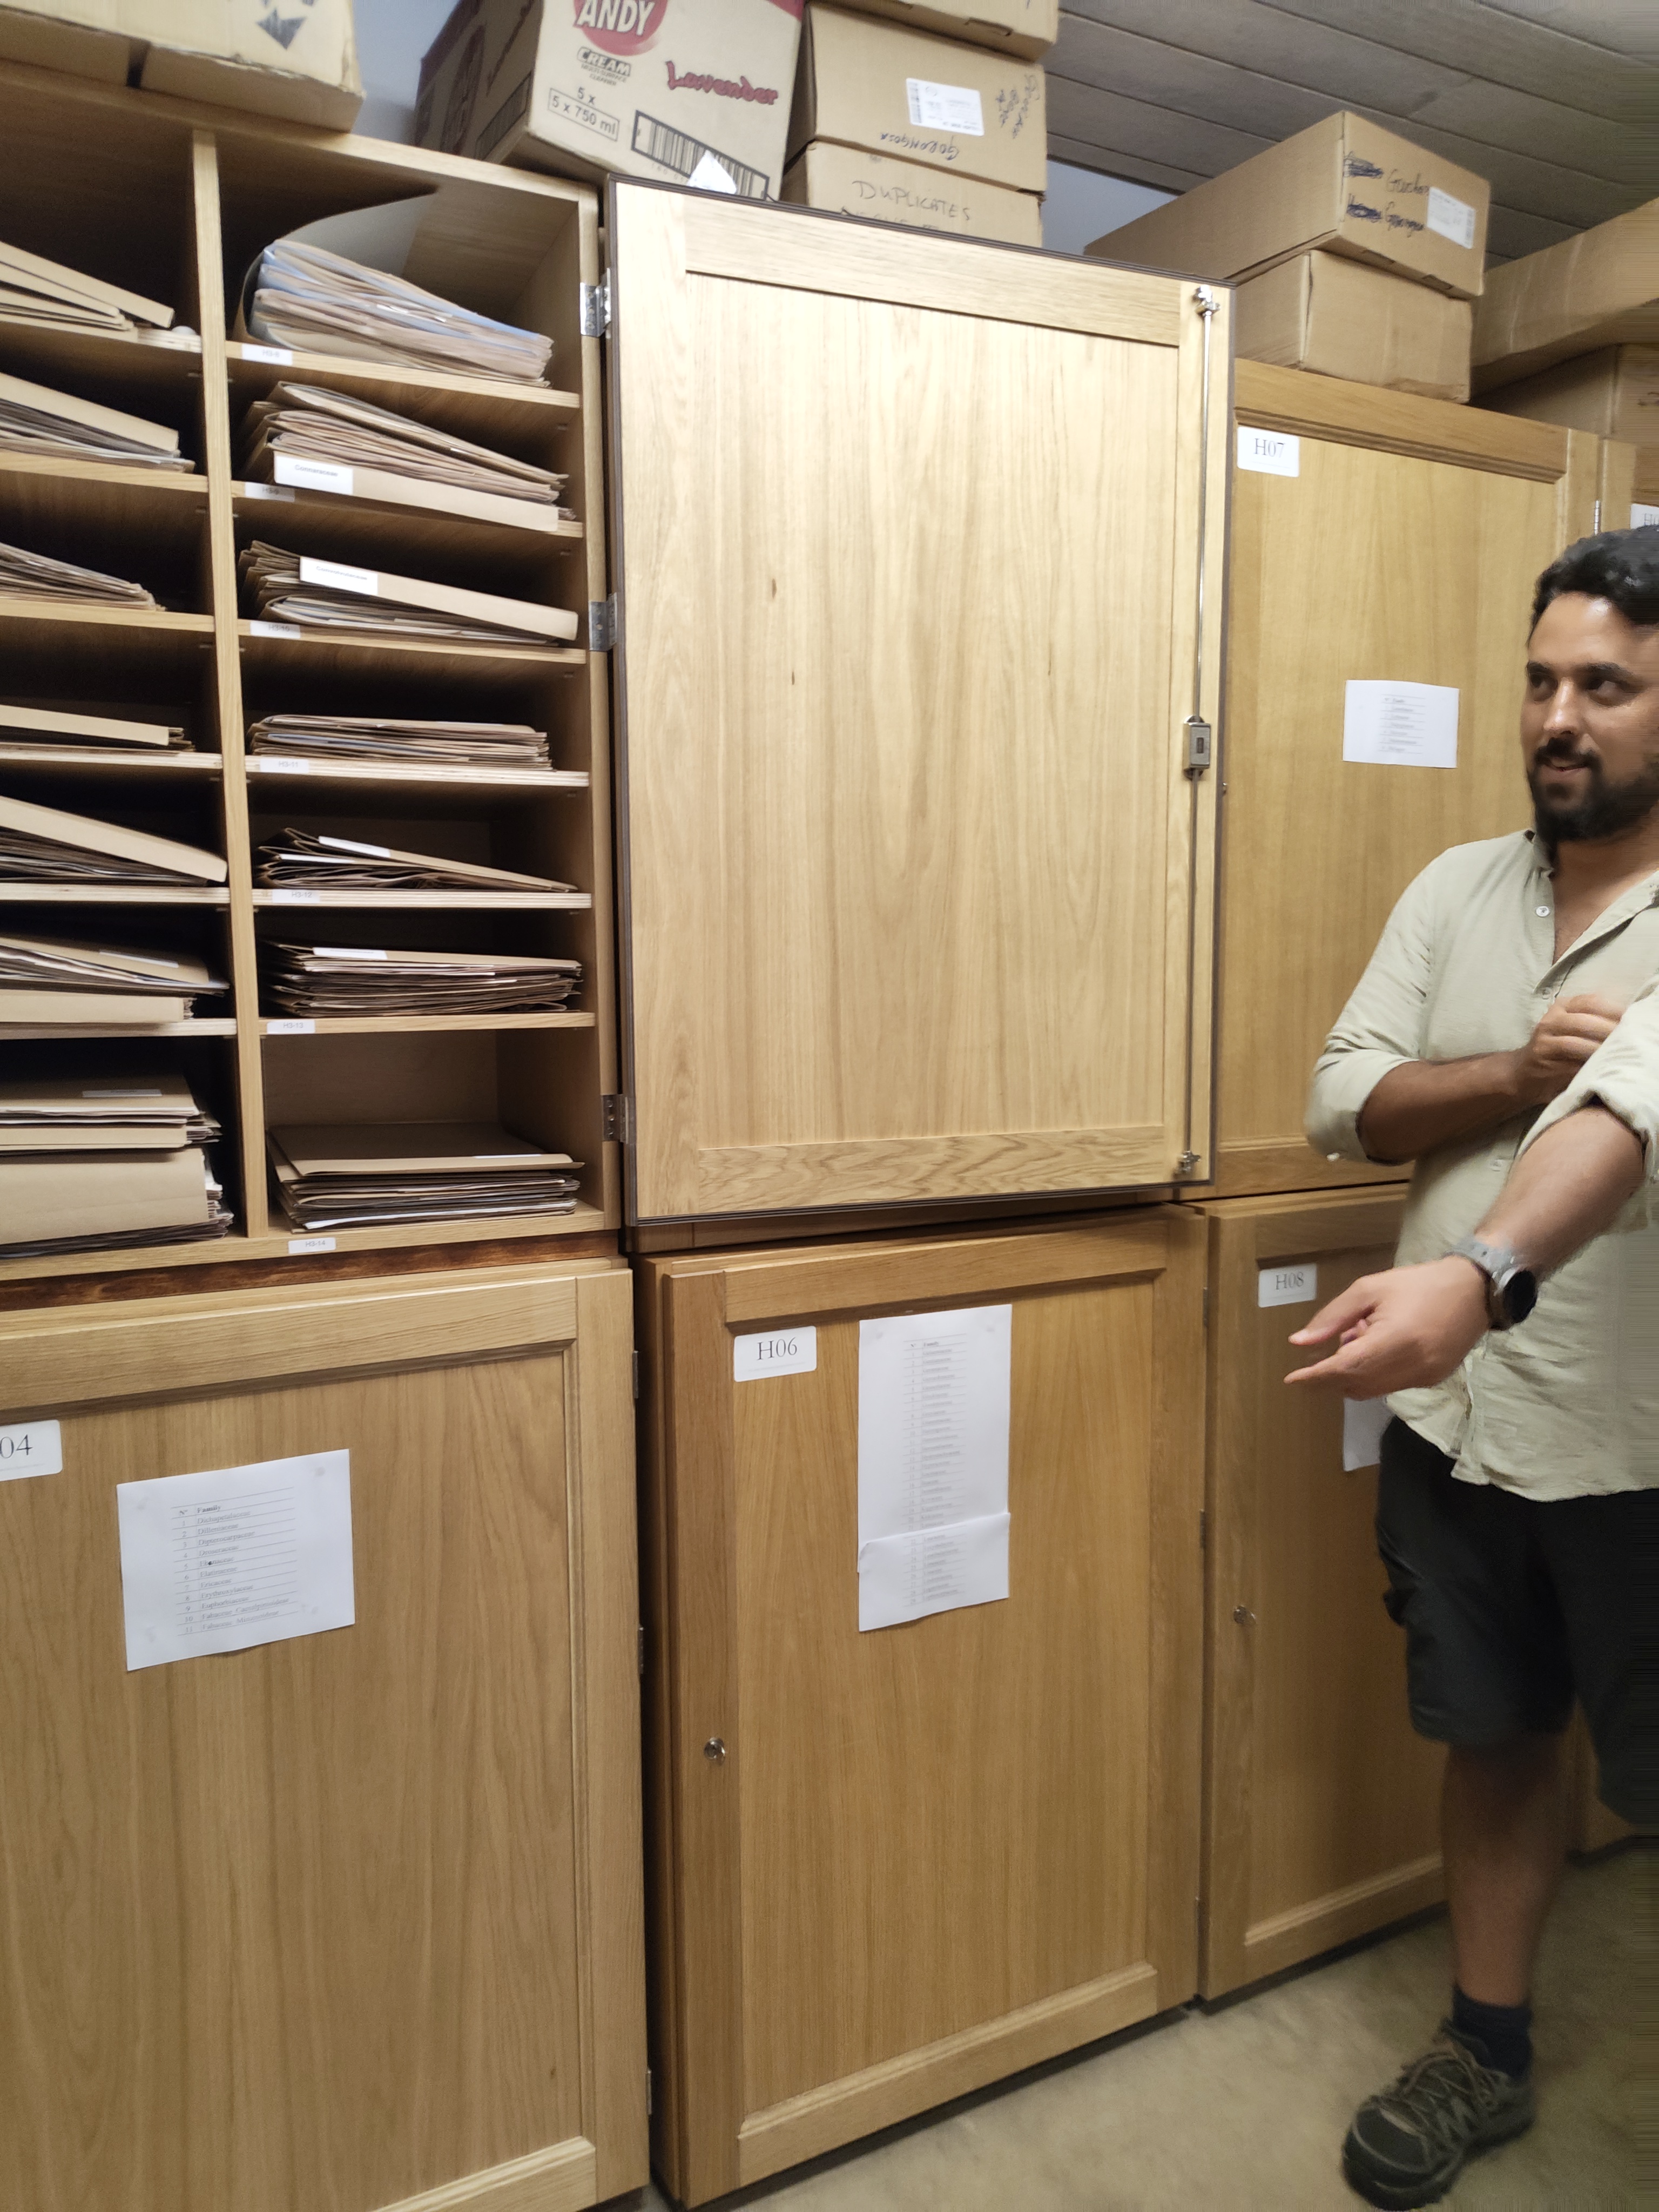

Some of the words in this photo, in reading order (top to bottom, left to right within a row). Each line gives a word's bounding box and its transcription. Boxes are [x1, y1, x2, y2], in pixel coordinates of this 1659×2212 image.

[576, 0, 655, 36] ANDY
[578, 47, 631, 77] CREAM
[665, 60, 778, 105] Lavender
[578, 86, 585, 100] 5
[588, 95, 596, 104] x
[552, 95, 559, 107] 5
[563, 103, 570, 113] x
[575, 105, 597, 125] 750
[599, 120, 616, 134] ml
[1254, 437, 1285, 458] H07
[1275, 1271, 1304, 1290] H08
[757, 1337, 798, 1360] H06
[0, 1434, 33, 1459] 04
[197, 1505, 222, 1514] Family
